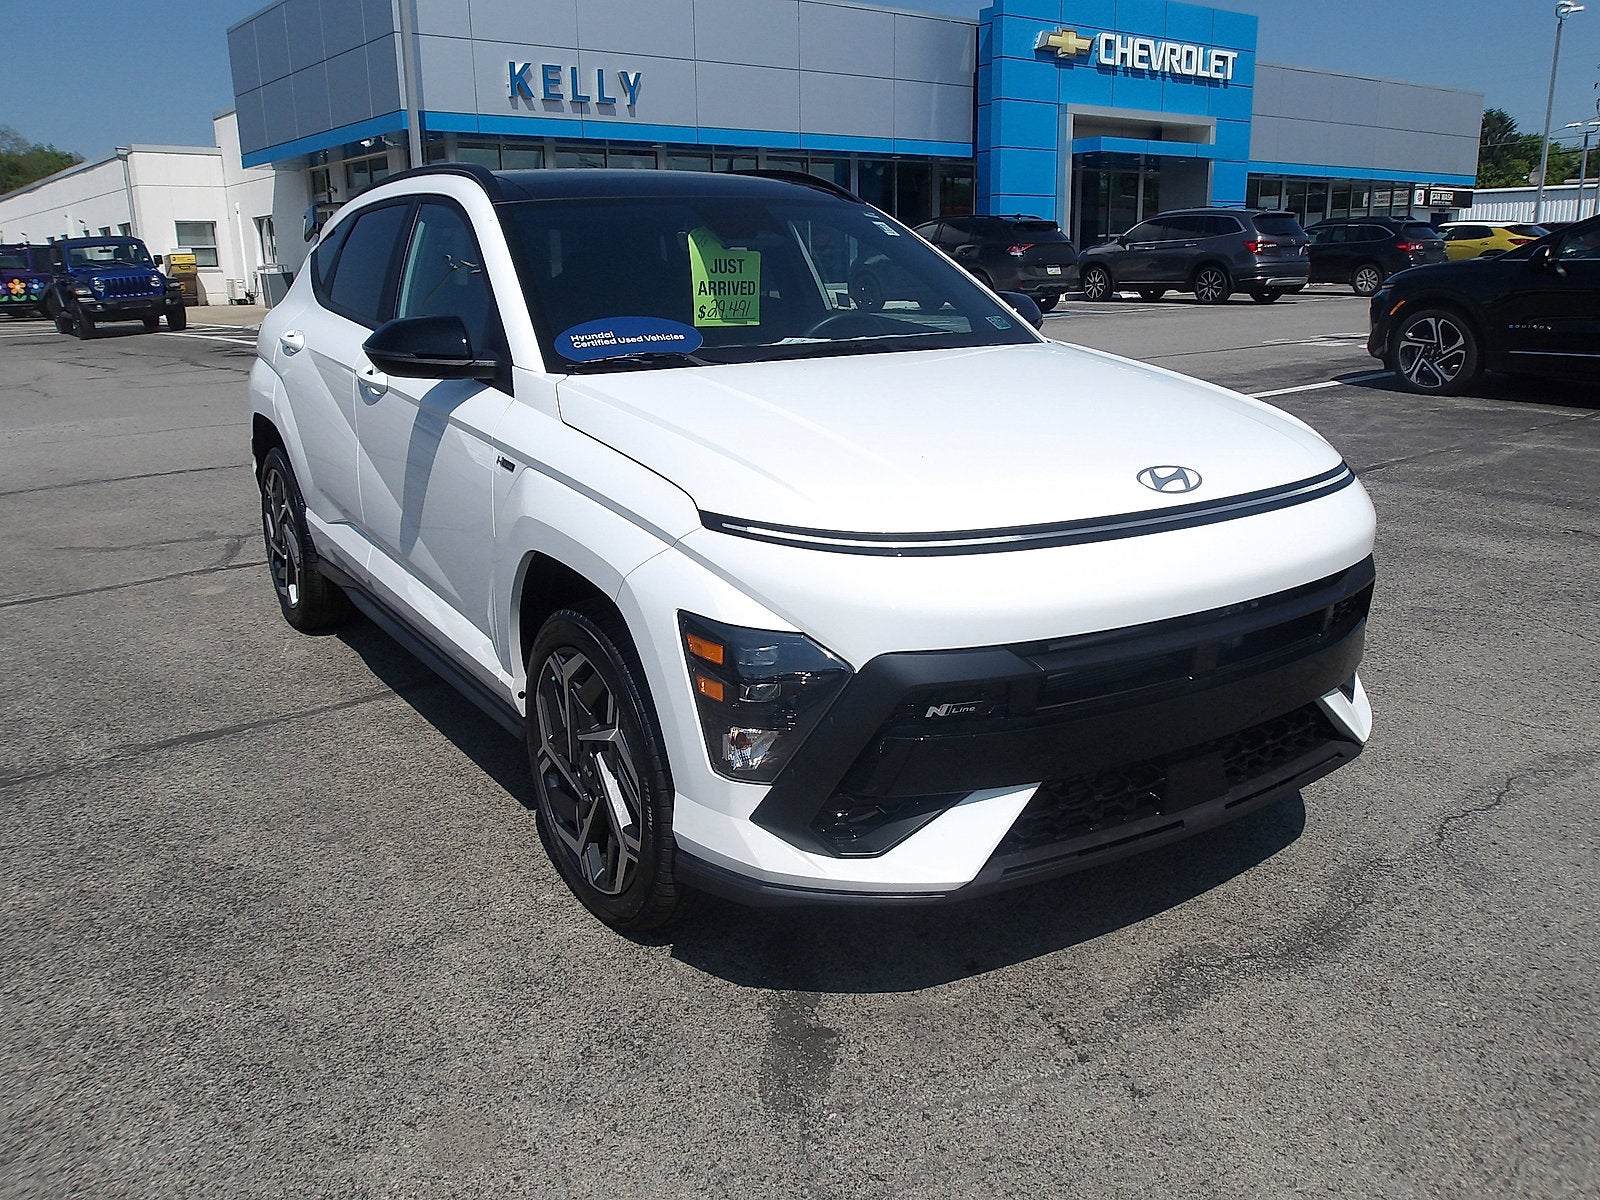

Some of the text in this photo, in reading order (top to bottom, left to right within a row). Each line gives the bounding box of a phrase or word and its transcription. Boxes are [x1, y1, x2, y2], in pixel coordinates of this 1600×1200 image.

[1097, 32, 1238, 80] CHEVROLET
[508, 61, 642, 105] KELLY
[710, 258, 745, 274] JUST
[697, 280, 756, 296] ARRIVED
[570, 330, 615, 343] Hyundai
[572, 332, 685, 349] Certified Used Vehicles
[951, 706, 976, 714] Line
